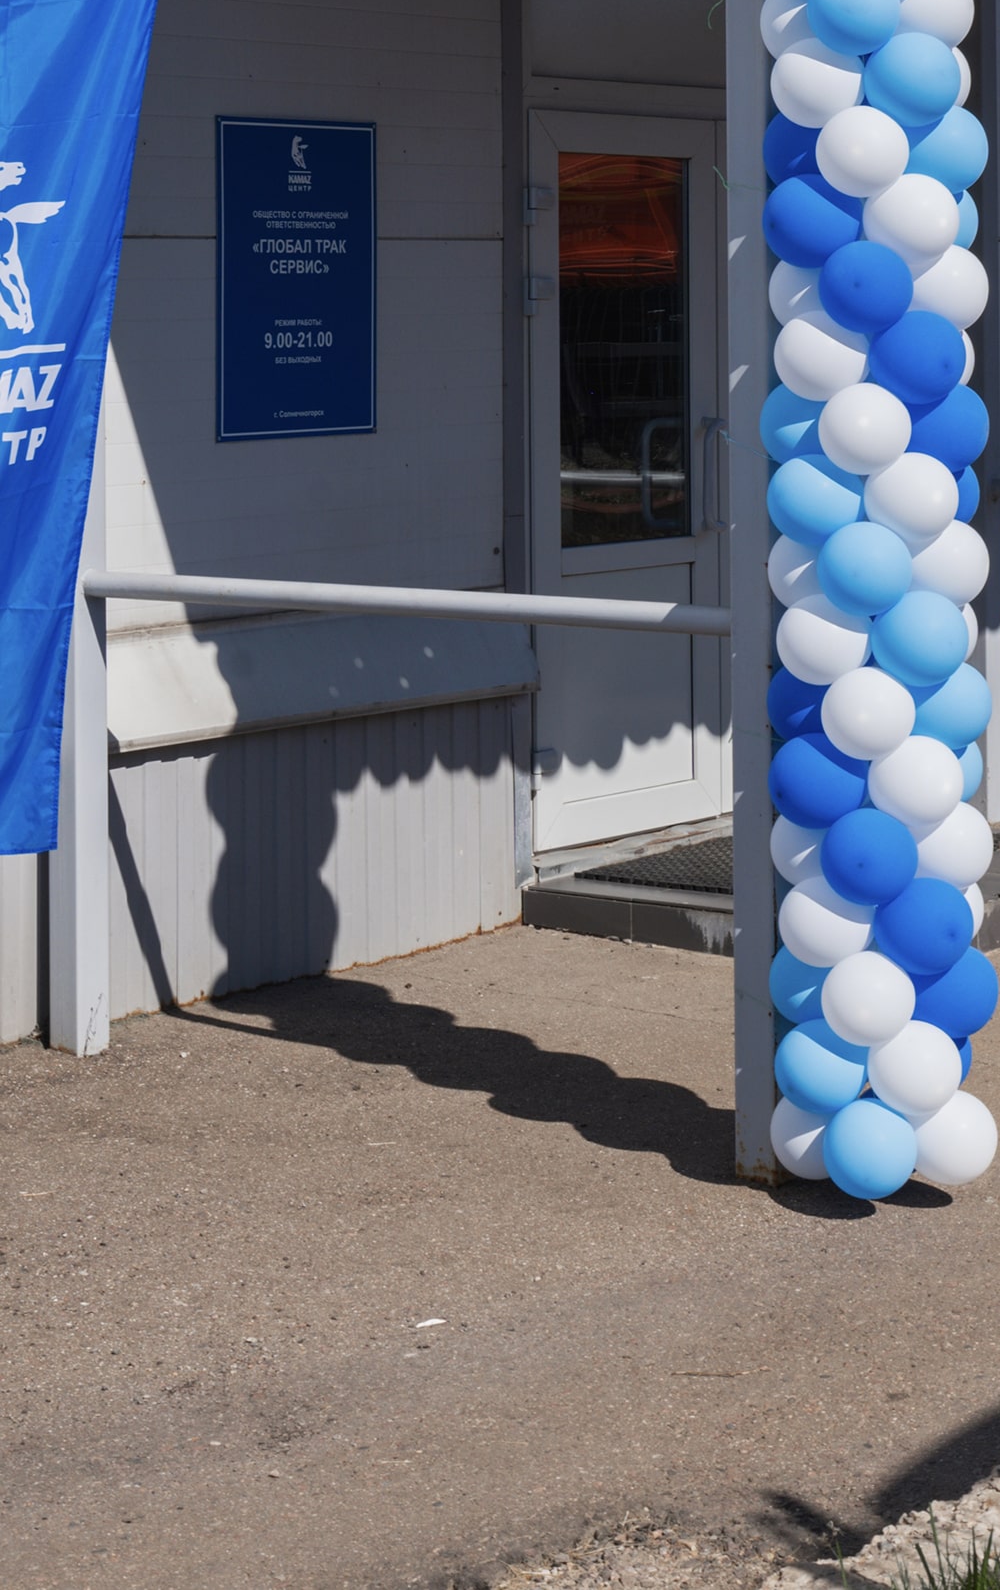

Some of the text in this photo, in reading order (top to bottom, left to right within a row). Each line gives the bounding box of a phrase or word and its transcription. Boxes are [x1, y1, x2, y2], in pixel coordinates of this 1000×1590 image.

[288, 174, 312, 185] KAMAZ
[252, 210, 290, 219] ОБЩЕСТВО
[297, 210, 349, 220] ОГРАНИЧЕННОЙ
[265, 220, 336, 229] ОТВЕТСТВЕННОСТЬЮ
[252, 238, 347, 254] «ГЛОБАЛ ТРАК
[269, 259, 330, 274] СЕРВИС»
[274, 319, 296, 327] РЕЖИМ
[264, 331, 333, 349] 9.00-21.00
[275, 356, 322, 364] БЕЗ ВЫХОДНЫХ
